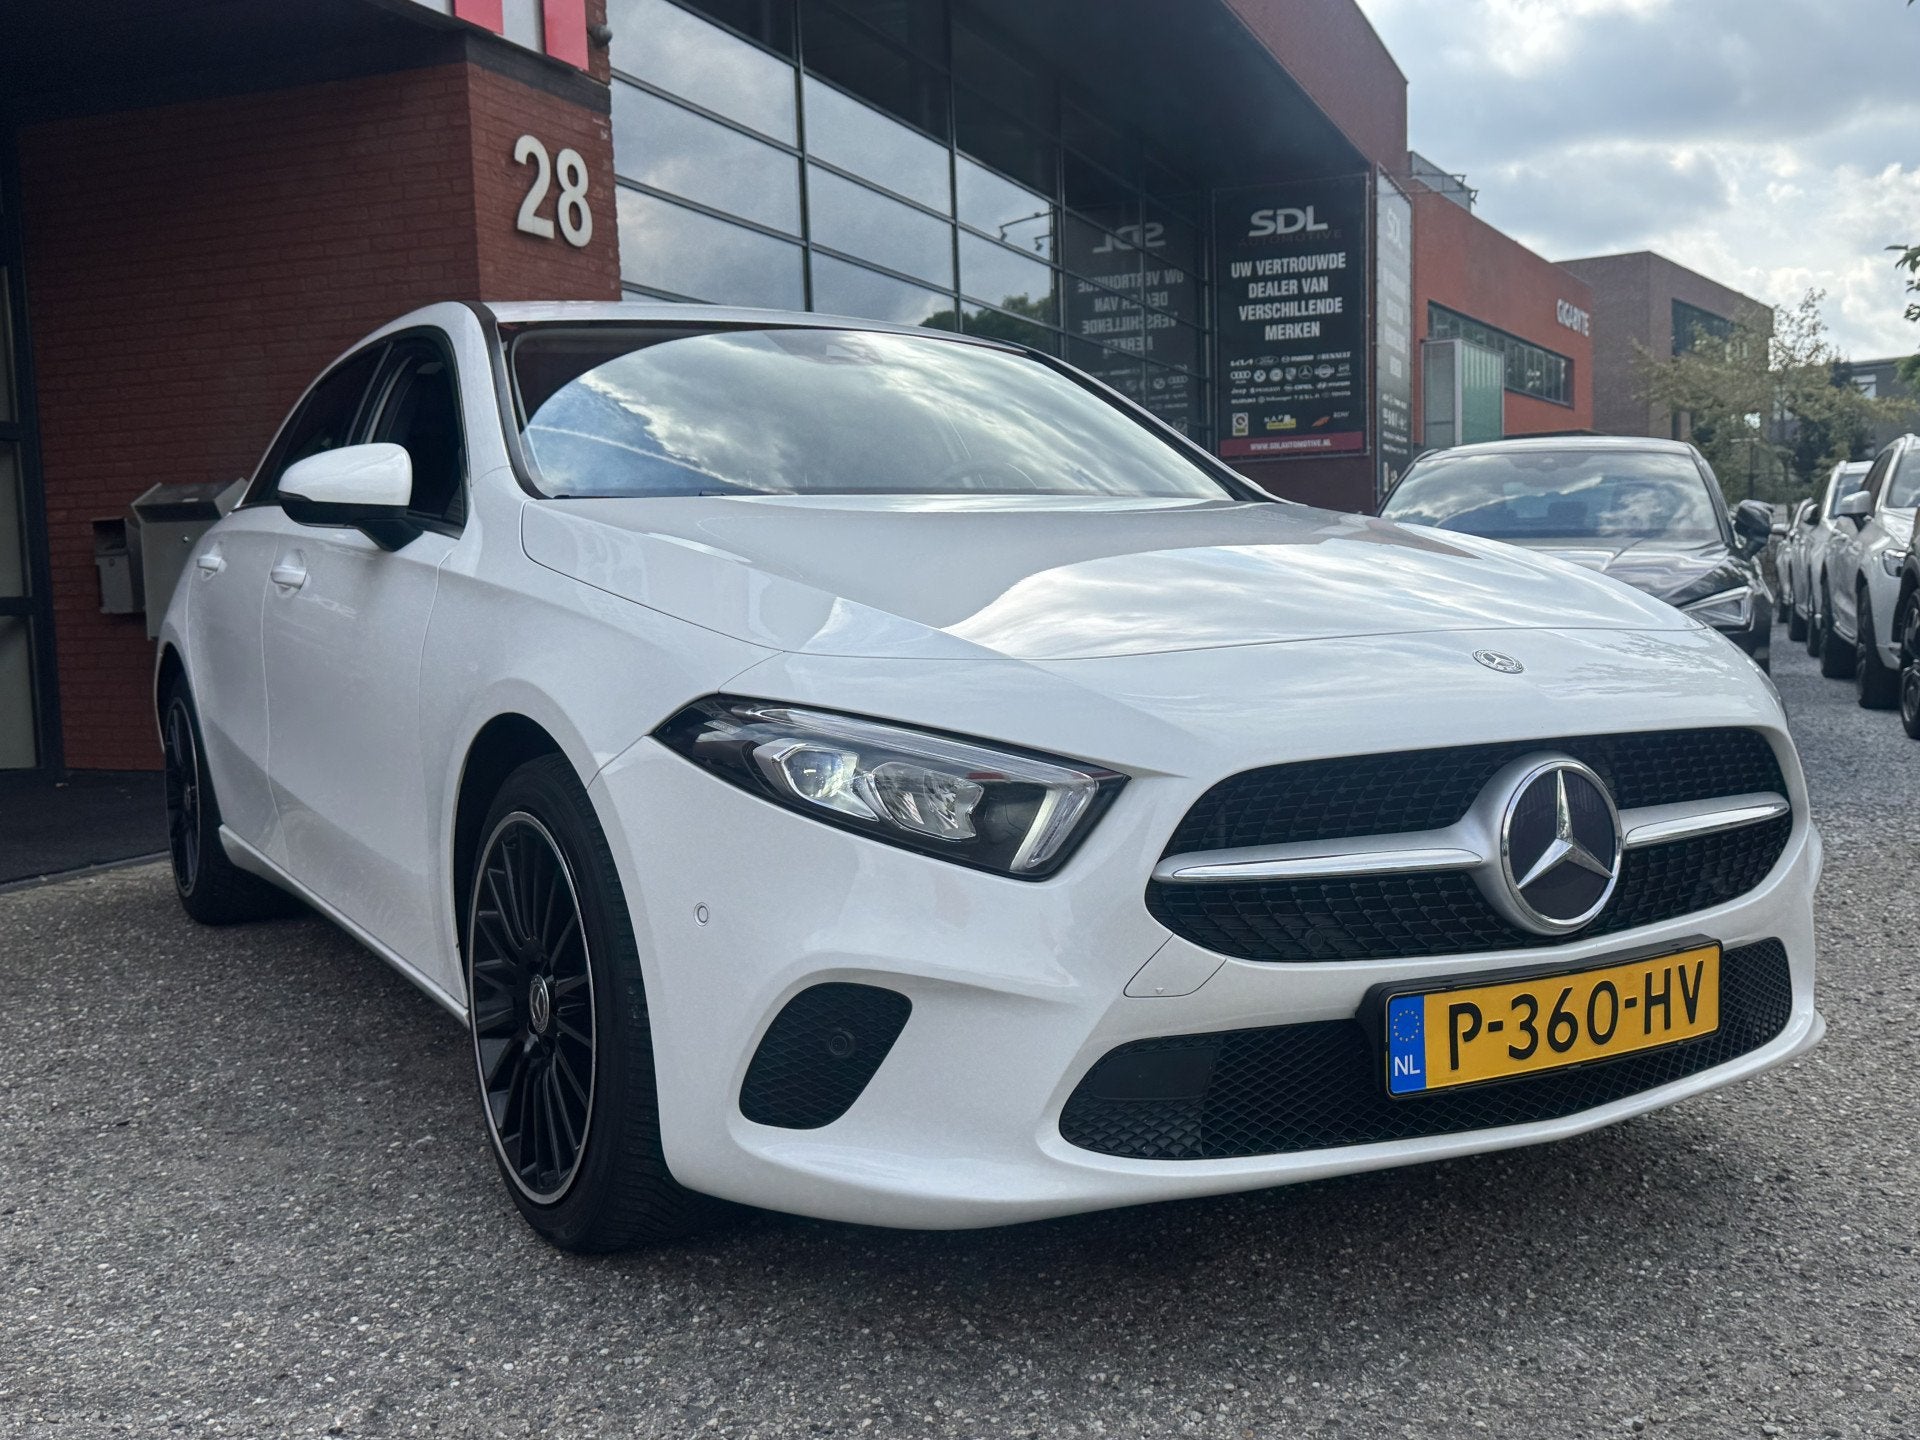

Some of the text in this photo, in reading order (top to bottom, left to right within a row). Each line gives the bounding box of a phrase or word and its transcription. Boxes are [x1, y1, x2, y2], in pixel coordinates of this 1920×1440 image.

[514, 134, 593, 247] 28
[1248, 205, 1328, 237] SDL
[1231, 252, 1346, 278] UW VERTROUWDE
[1248, 276, 1328, 299] DEALER VAN
[1239, 297, 1343, 321] VERSCHILLENDE
[1265, 321, 1320, 341] MERKEN
[1448, 960, 1704, 1071] P-360-HV
[1394, 1056, 1420, 1077] NL
